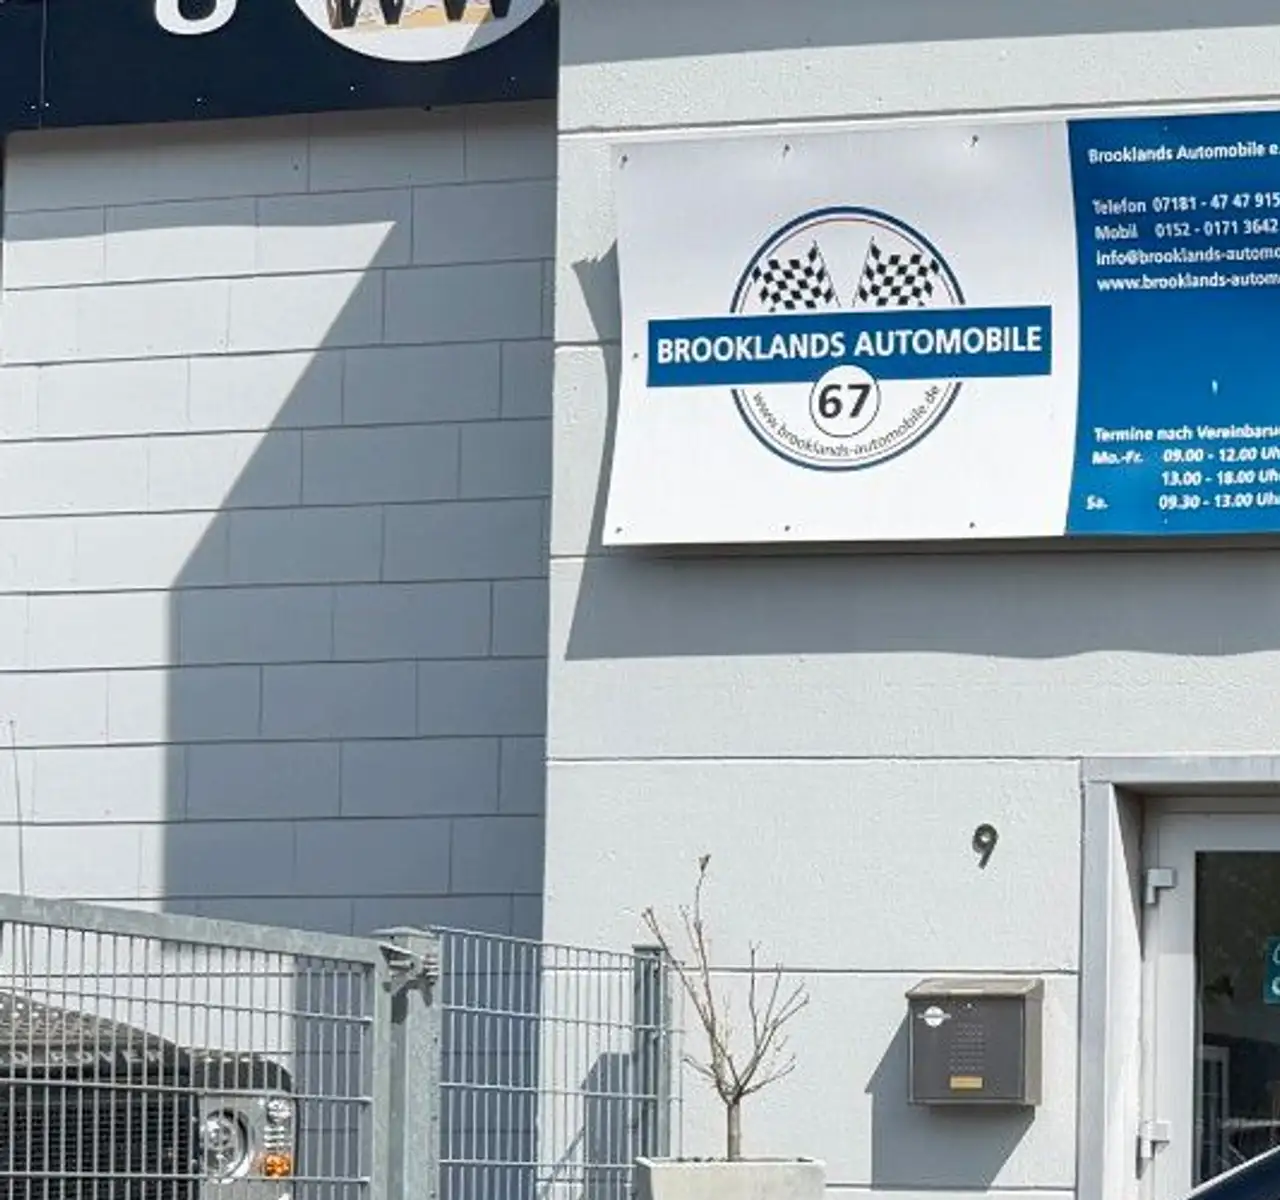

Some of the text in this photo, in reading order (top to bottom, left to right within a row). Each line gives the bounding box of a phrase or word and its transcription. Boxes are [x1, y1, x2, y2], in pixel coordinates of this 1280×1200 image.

[1088, 144, 1173, 165] Brooklands
[1176, 141, 1266, 161] Automobile
[1092, 198, 1147, 215] Telefon
[1152, 196, 1197, 213] 07181
[1210, 194, 1228, 210] 47
[1232, 193, 1250, 209] 47
[1094, 224, 1139, 240] Mobil
[1154, 222, 1191, 239] 0152
[1204, 220, 1238, 237] 0171
[1244, 218, 1279, 235] 3642
[656, 325, 1042, 365] BROOKLANDS AUTOMOBILE
[818, 383, 872, 420] 67
[1094, 427, 1153, 443] Termine
[1157, 425, 1193, 441] nach
[1163, 448, 1204, 463] 09.00
[1219, 447, 1257, 462] 12.00
[1161, 471, 1201, 486] 13.00
[1086, 495, 1108, 510] Sa.
[972, 823, 999, 870] 9
